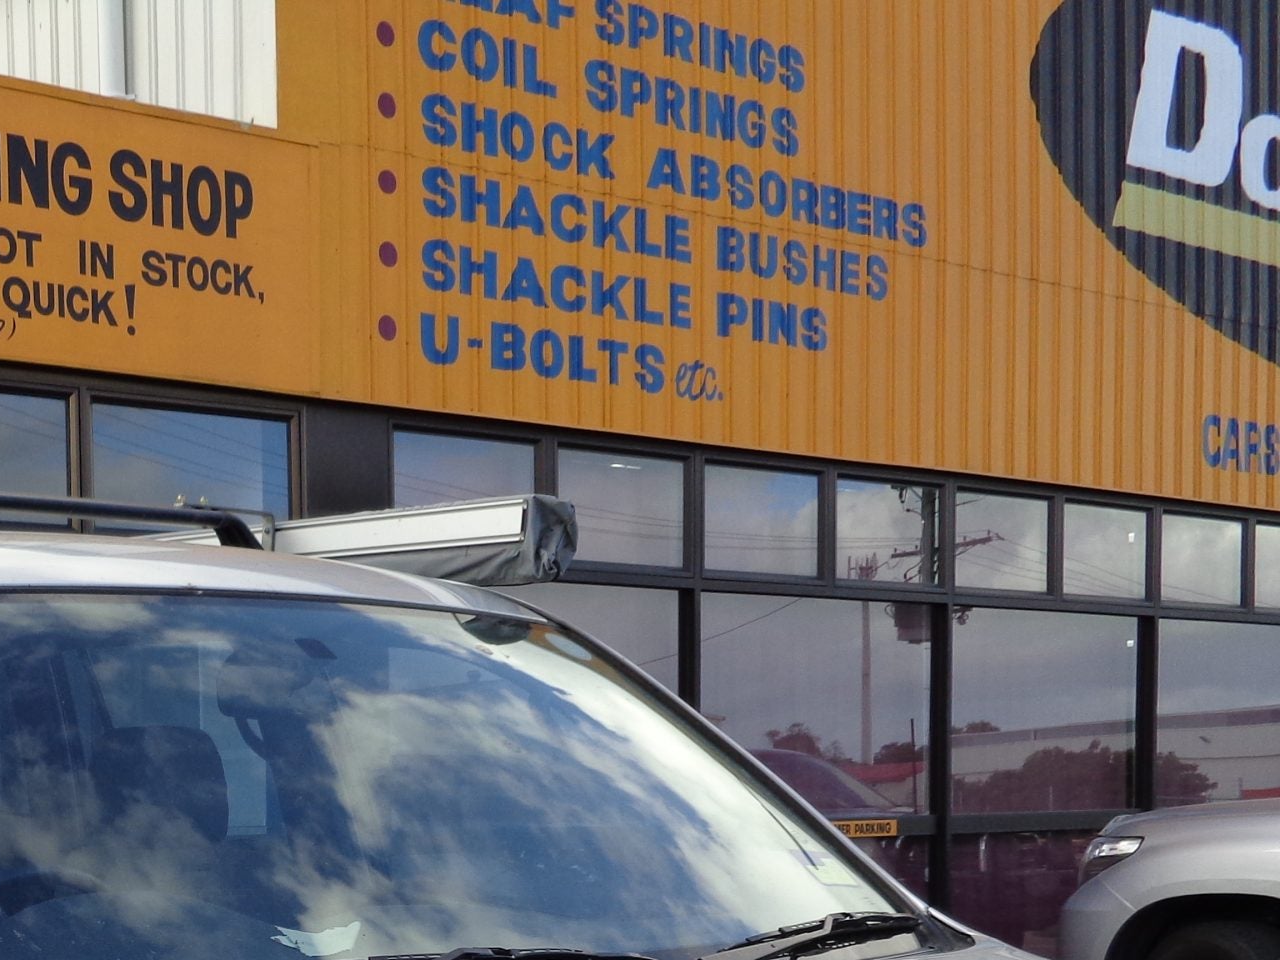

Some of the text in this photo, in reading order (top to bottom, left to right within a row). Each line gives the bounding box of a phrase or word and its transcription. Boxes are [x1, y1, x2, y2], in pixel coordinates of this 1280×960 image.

[418, 18, 800, 157] COIL SPRINGS
[595, 0, 805, 94] SPRINGS
[108, 148, 254, 240] SHOP
[421, 92, 928, 248] SHOCK ABSORBERS
[79, 239, 115, 280] IN
[141, 250, 265, 305] STOCK,
[422, 166, 889, 301] SHACKLE BUSHES
[422, 239, 829, 352] SHACKLE PINS
[421, 311, 724, 401] U-BOLTS etc.
[854, 822, 892, 834] PARKING
